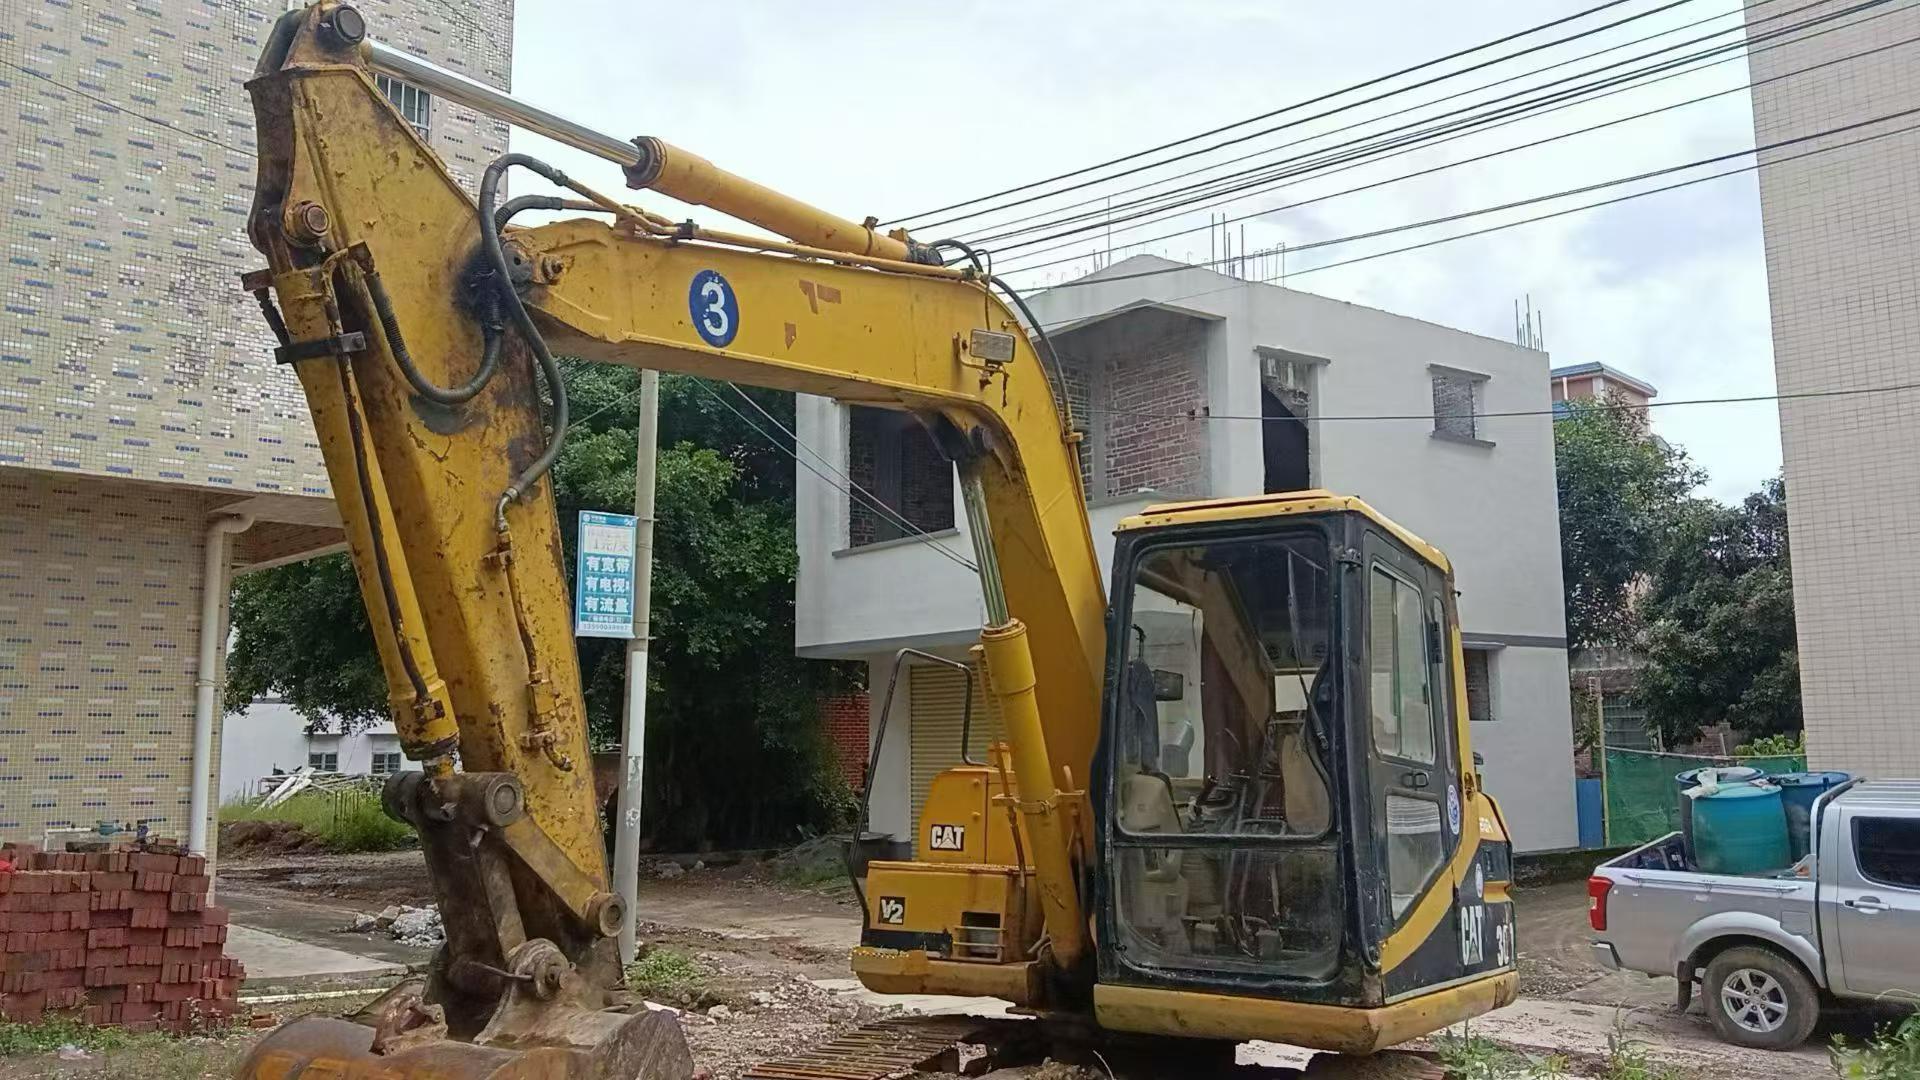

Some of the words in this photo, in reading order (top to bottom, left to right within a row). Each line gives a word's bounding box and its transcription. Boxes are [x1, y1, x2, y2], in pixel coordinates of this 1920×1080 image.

[701, 280, 729, 337] 3
[586, 555, 631, 573] 有宽带
[585, 575, 626, 593] 有电视
[584, 596, 629, 613] 有流量
[931, 825, 965, 850] CAT
[881, 899, 904, 924] V2
[1461, 905, 1484, 966] CAT
